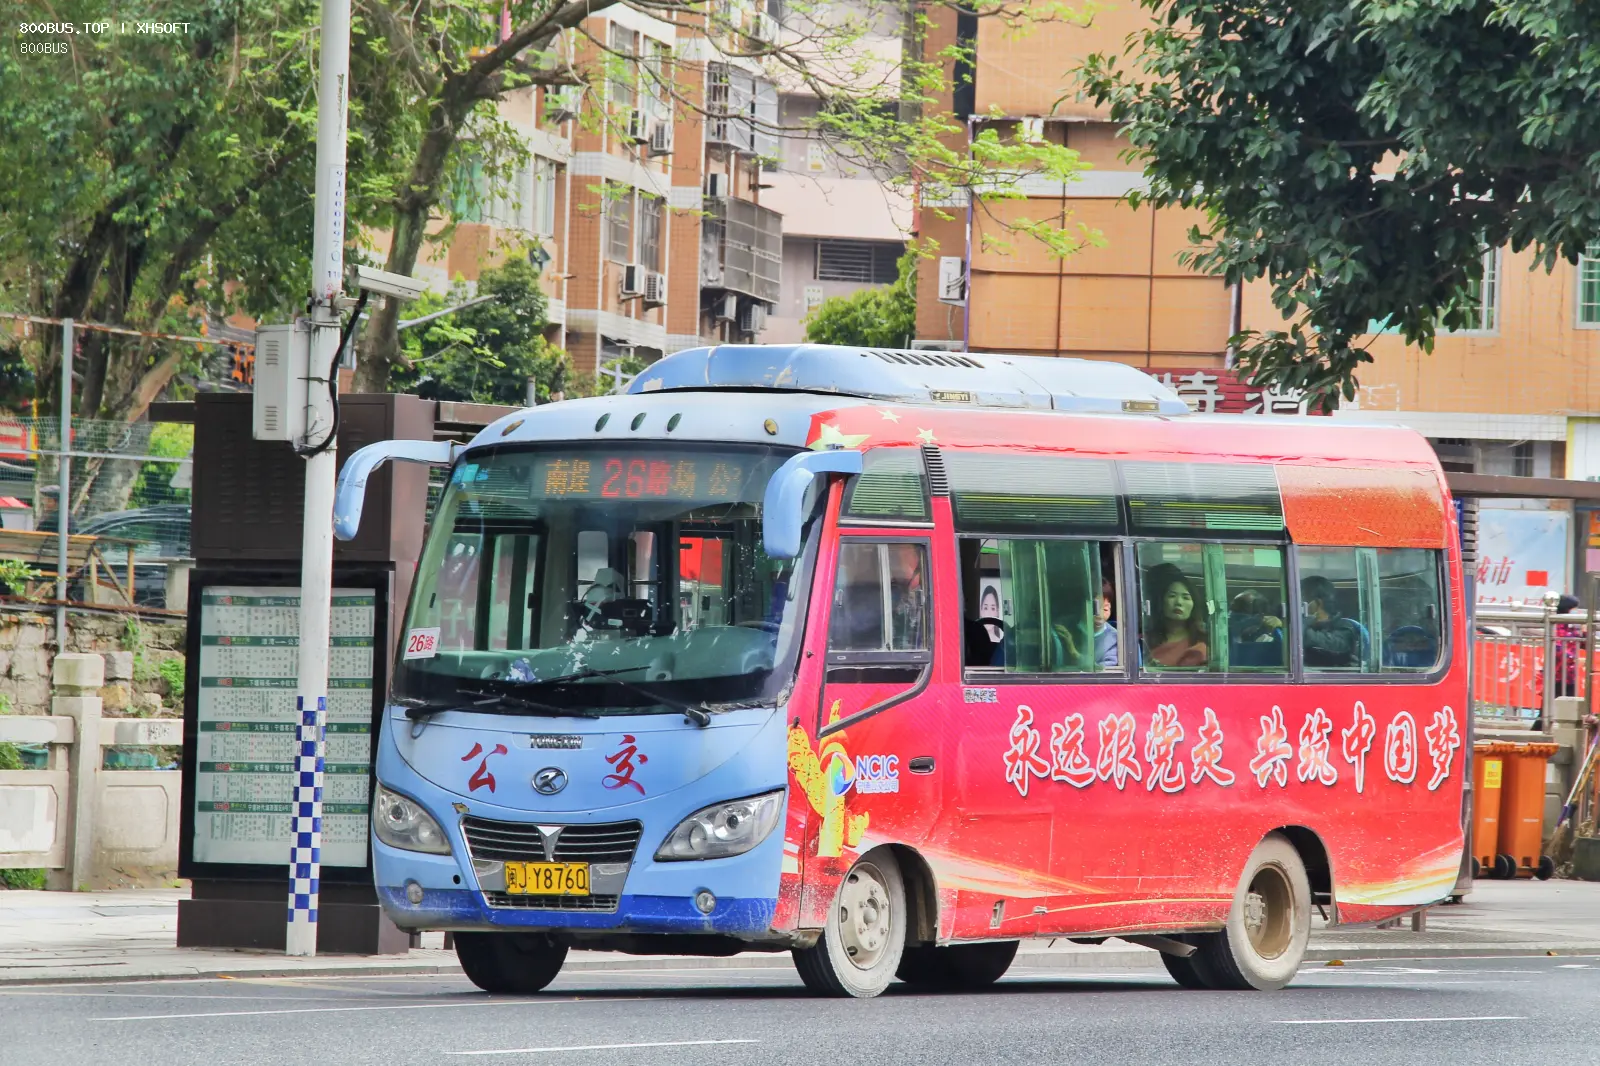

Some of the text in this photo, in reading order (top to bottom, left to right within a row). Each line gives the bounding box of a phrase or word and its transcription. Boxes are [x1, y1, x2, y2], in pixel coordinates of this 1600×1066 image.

[407, 634, 435, 653] 26路
[1003, 700, 1461, 797] 永远跟党走 共筑中国梦
[856, 755, 899, 779] NCIC
